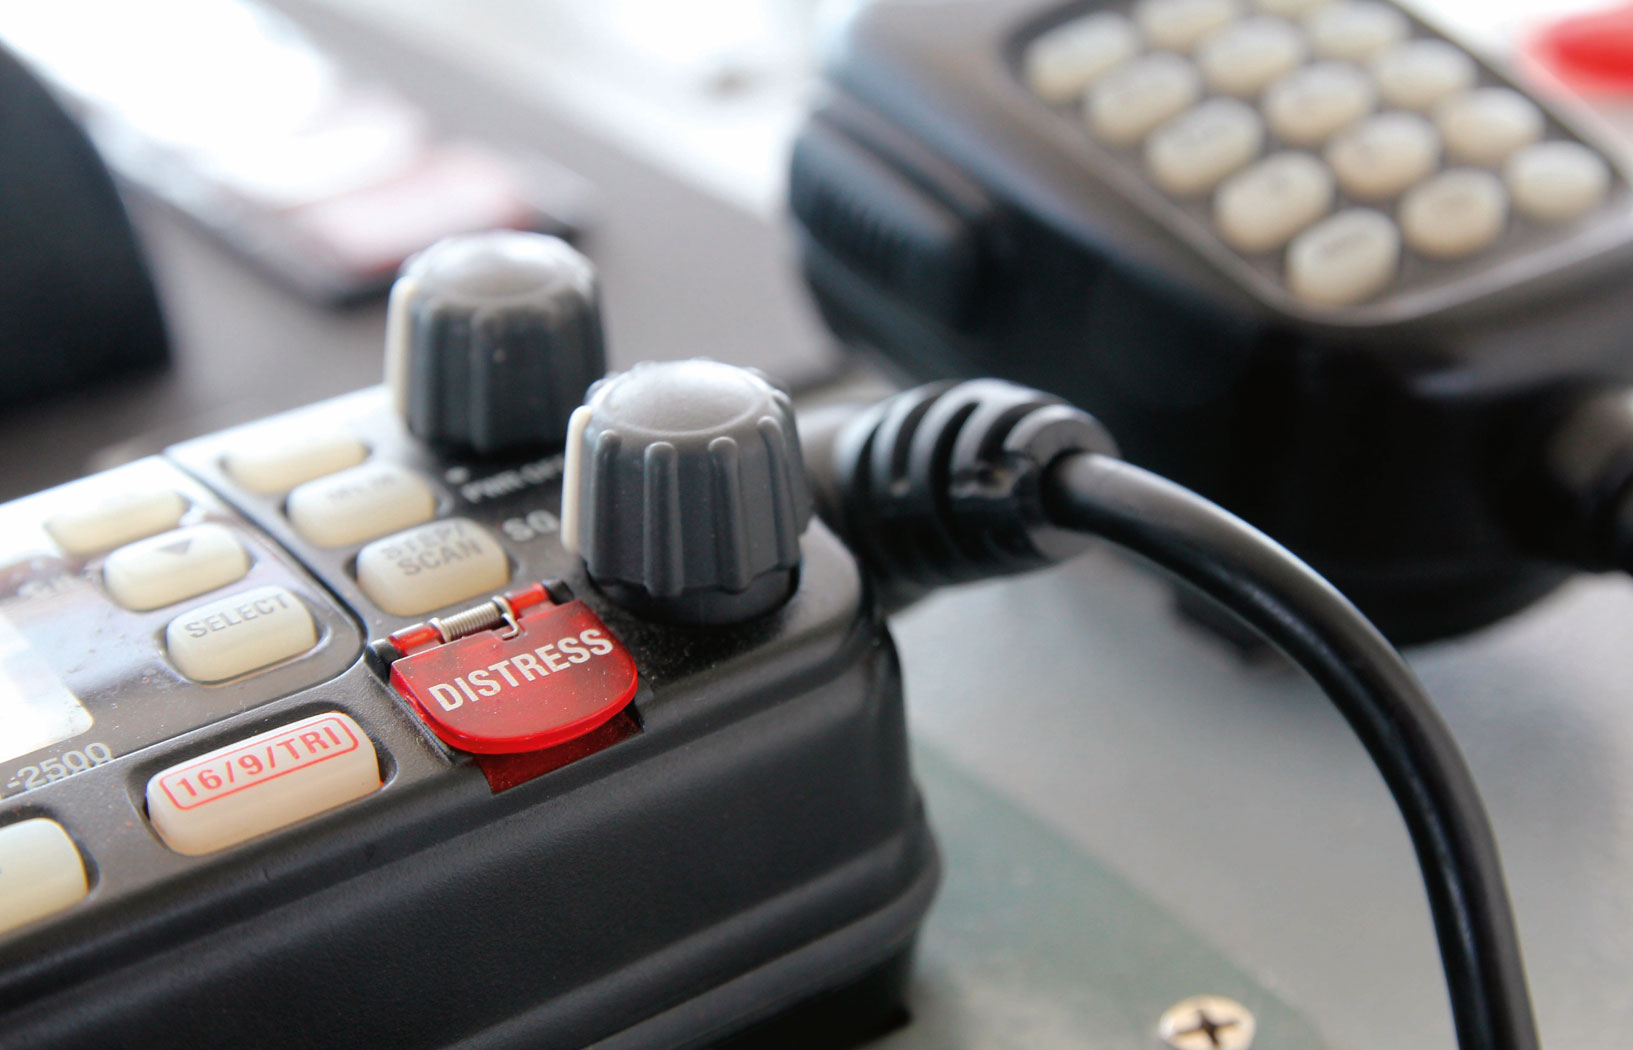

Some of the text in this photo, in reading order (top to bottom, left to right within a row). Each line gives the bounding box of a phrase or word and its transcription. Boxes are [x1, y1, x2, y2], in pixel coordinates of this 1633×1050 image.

[397, 540, 484, 576] SCAN
[184, 594, 292, 640] SELECT
[427, 629, 614, 712] DISTRESS
[175, 726, 343, 797] 16/9/TRI
